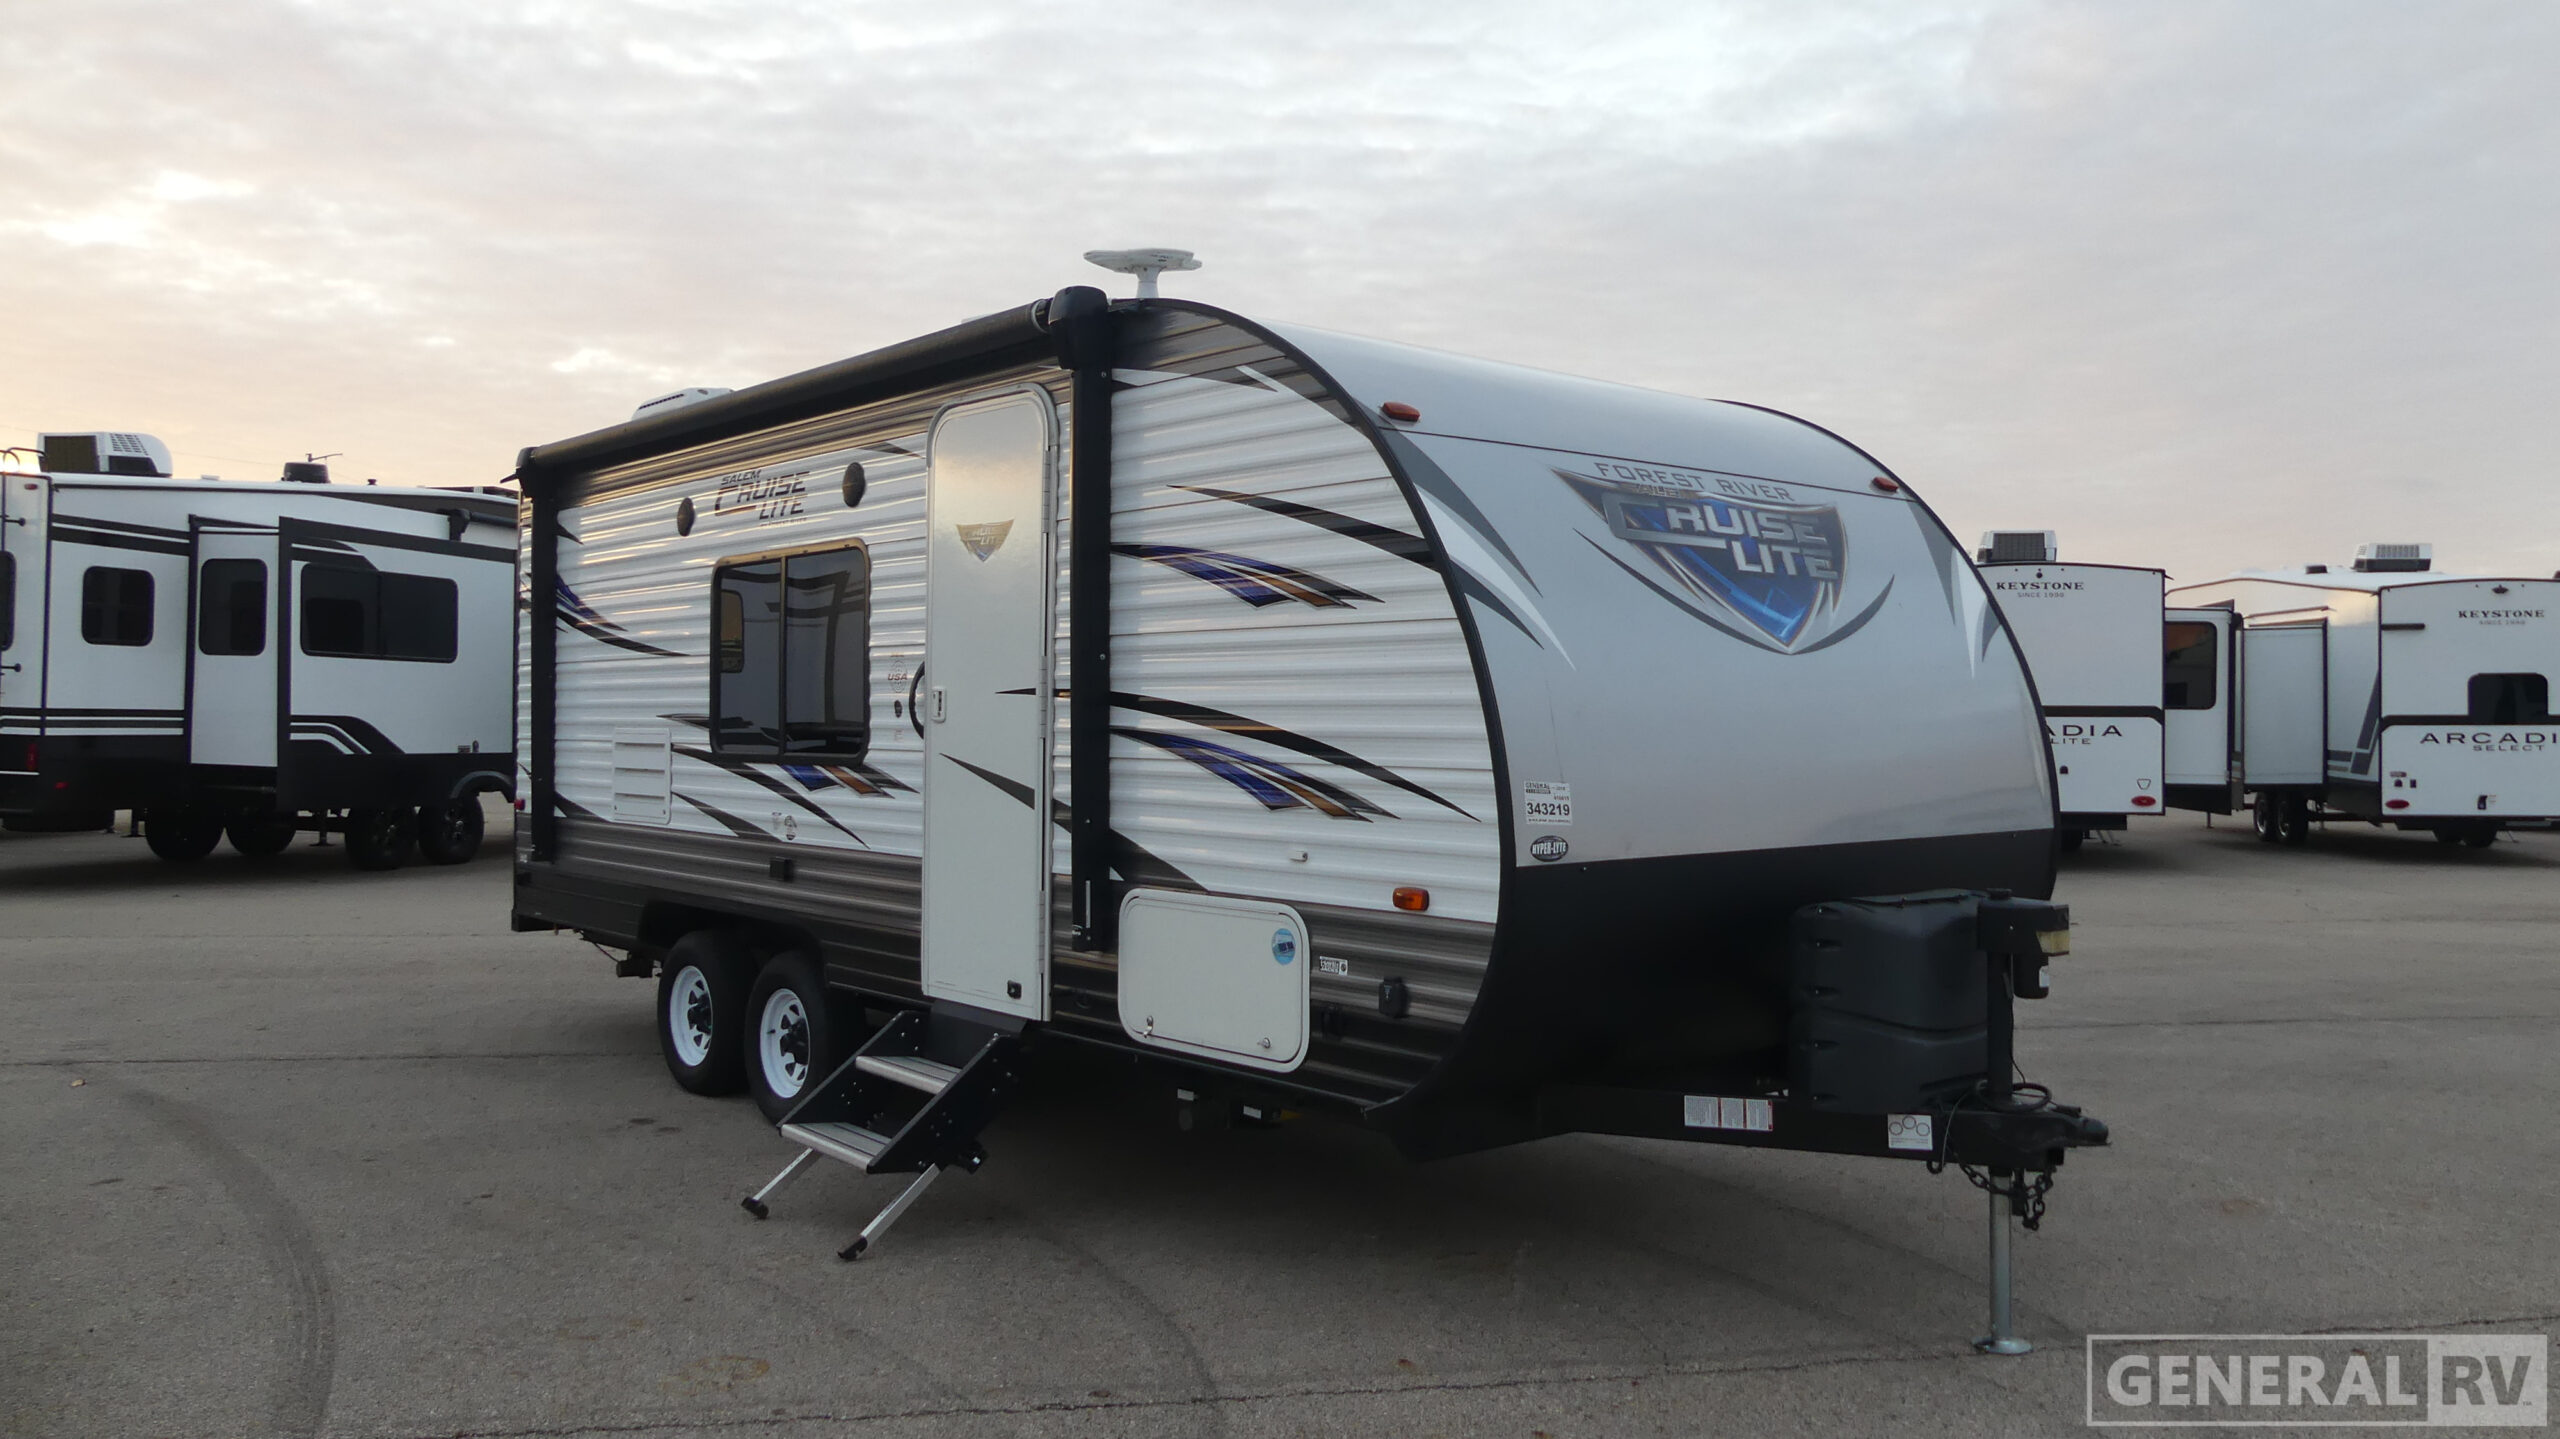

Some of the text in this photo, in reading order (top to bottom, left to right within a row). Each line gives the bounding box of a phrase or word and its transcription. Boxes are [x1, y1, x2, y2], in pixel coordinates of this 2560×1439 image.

[721, 469, 762, 486] SALEM
[1594, 462, 1795, 502] FOREST RIVER
[714, 471, 810, 517] CRUISE
[759, 494, 808, 520] LITE
[1602, 492, 1828, 549] CRUISE
[1730, 540, 1839, 580] LITE
[1996, 582, 2084, 590] KEYSTONE
[2458, 609, 2545, 619] KEYSTONE
[887, 673, 908, 681] USA
[2050, 737, 2091, 745] LITE
[2419, 732, 2557, 744] ARCADI
[2472, 744, 2545, 752] SELECT
[1527, 801, 1570, 816] 343219
[1531, 841, 1567, 855] HYPER-LYTE
